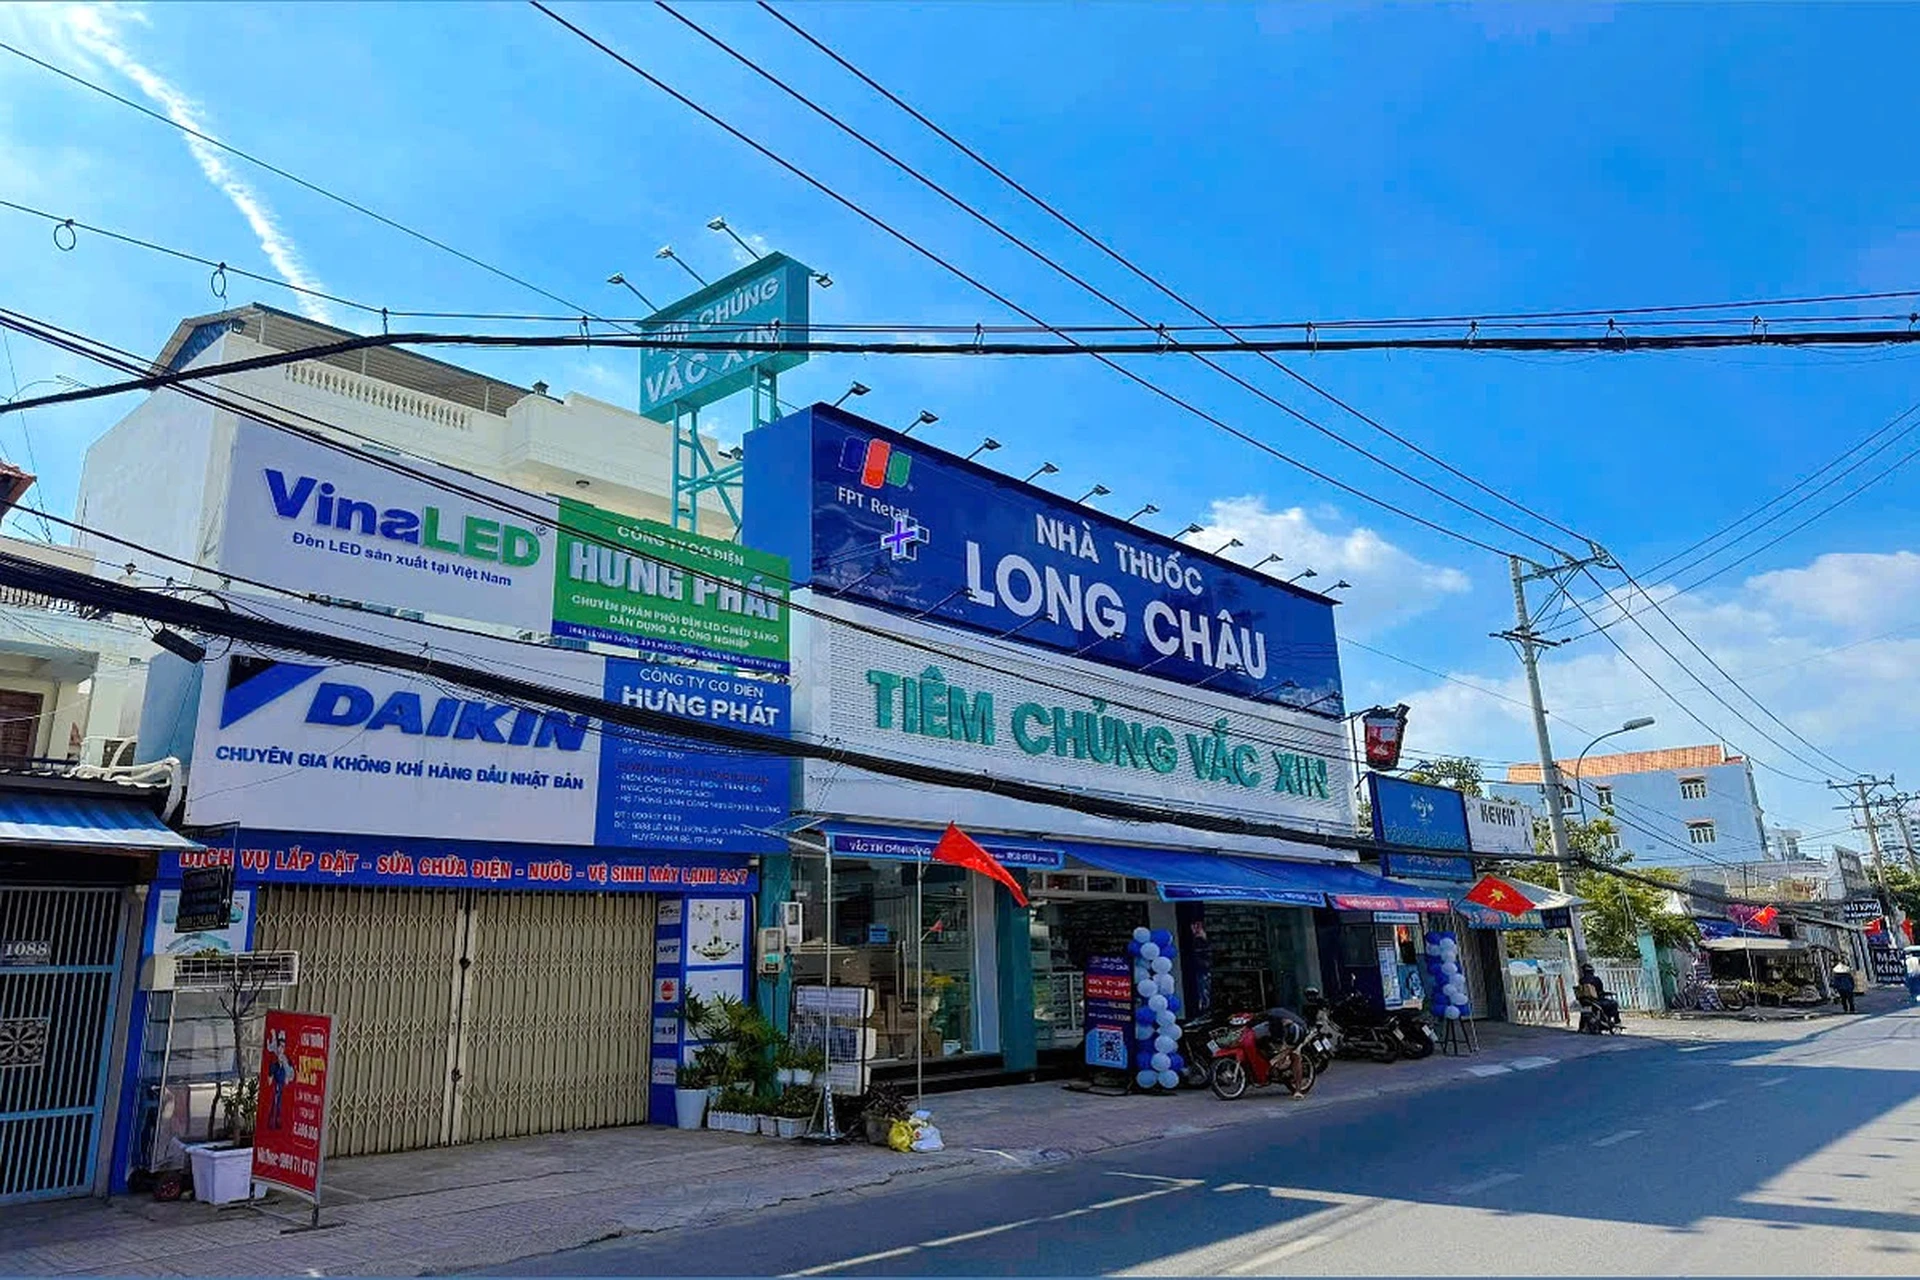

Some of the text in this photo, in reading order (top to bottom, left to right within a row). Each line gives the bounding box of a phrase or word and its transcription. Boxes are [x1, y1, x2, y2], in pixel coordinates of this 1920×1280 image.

[699, 277, 780, 331] CHỦNG
[646, 352, 709, 403] VẮC
[264, 468, 541, 567] VinaLED
[838, 486, 864, 508] FPT
[293, 531, 511, 586] Đèn LED sản xuất tại Việt Nam
[617, 525, 665, 547] CÔNG
[713, 548, 743, 566] ĐIỆN
[1036, 514, 1203, 596] NHÀ THUỐC
[693, 575, 783, 621] PHÁT
[966, 541, 1267, 679] LONG CHÂU
[621, 685, 780, 727] HƯNG PHÁT
[639, 666, 764, 700] CÔNG TY CƠ ĐIỆN
[305, 682, 590, 752] DAIKIN
[868, 664, 1330, 800] TIÊM CHỦNG VẮC XIN
[216, 745, 583, 790] CHUYÊN GIA KHÔNG KHÍ HÀNG ĐẦU NHẬT BẢN
[241, 851, 270, 874] VỤ
[274, 847, 315, 871] LẮP
[319, 850, 359, 876] ĐẶT
[376, 855, 413, 876] SỬA
[418, 857, 469, 878] CHỮA
[472, 858, 512, 882] ĐIỆN
[527, 859, 572, 881] NƯỚC
[587, 863, 608, 886] VỆ
[611, 866, 645, 882] SINH
[649, 863, 680, 883] MÁY
[682, 866, 718, 887] LẠNH
[5, 941, 48, 957] 1088
